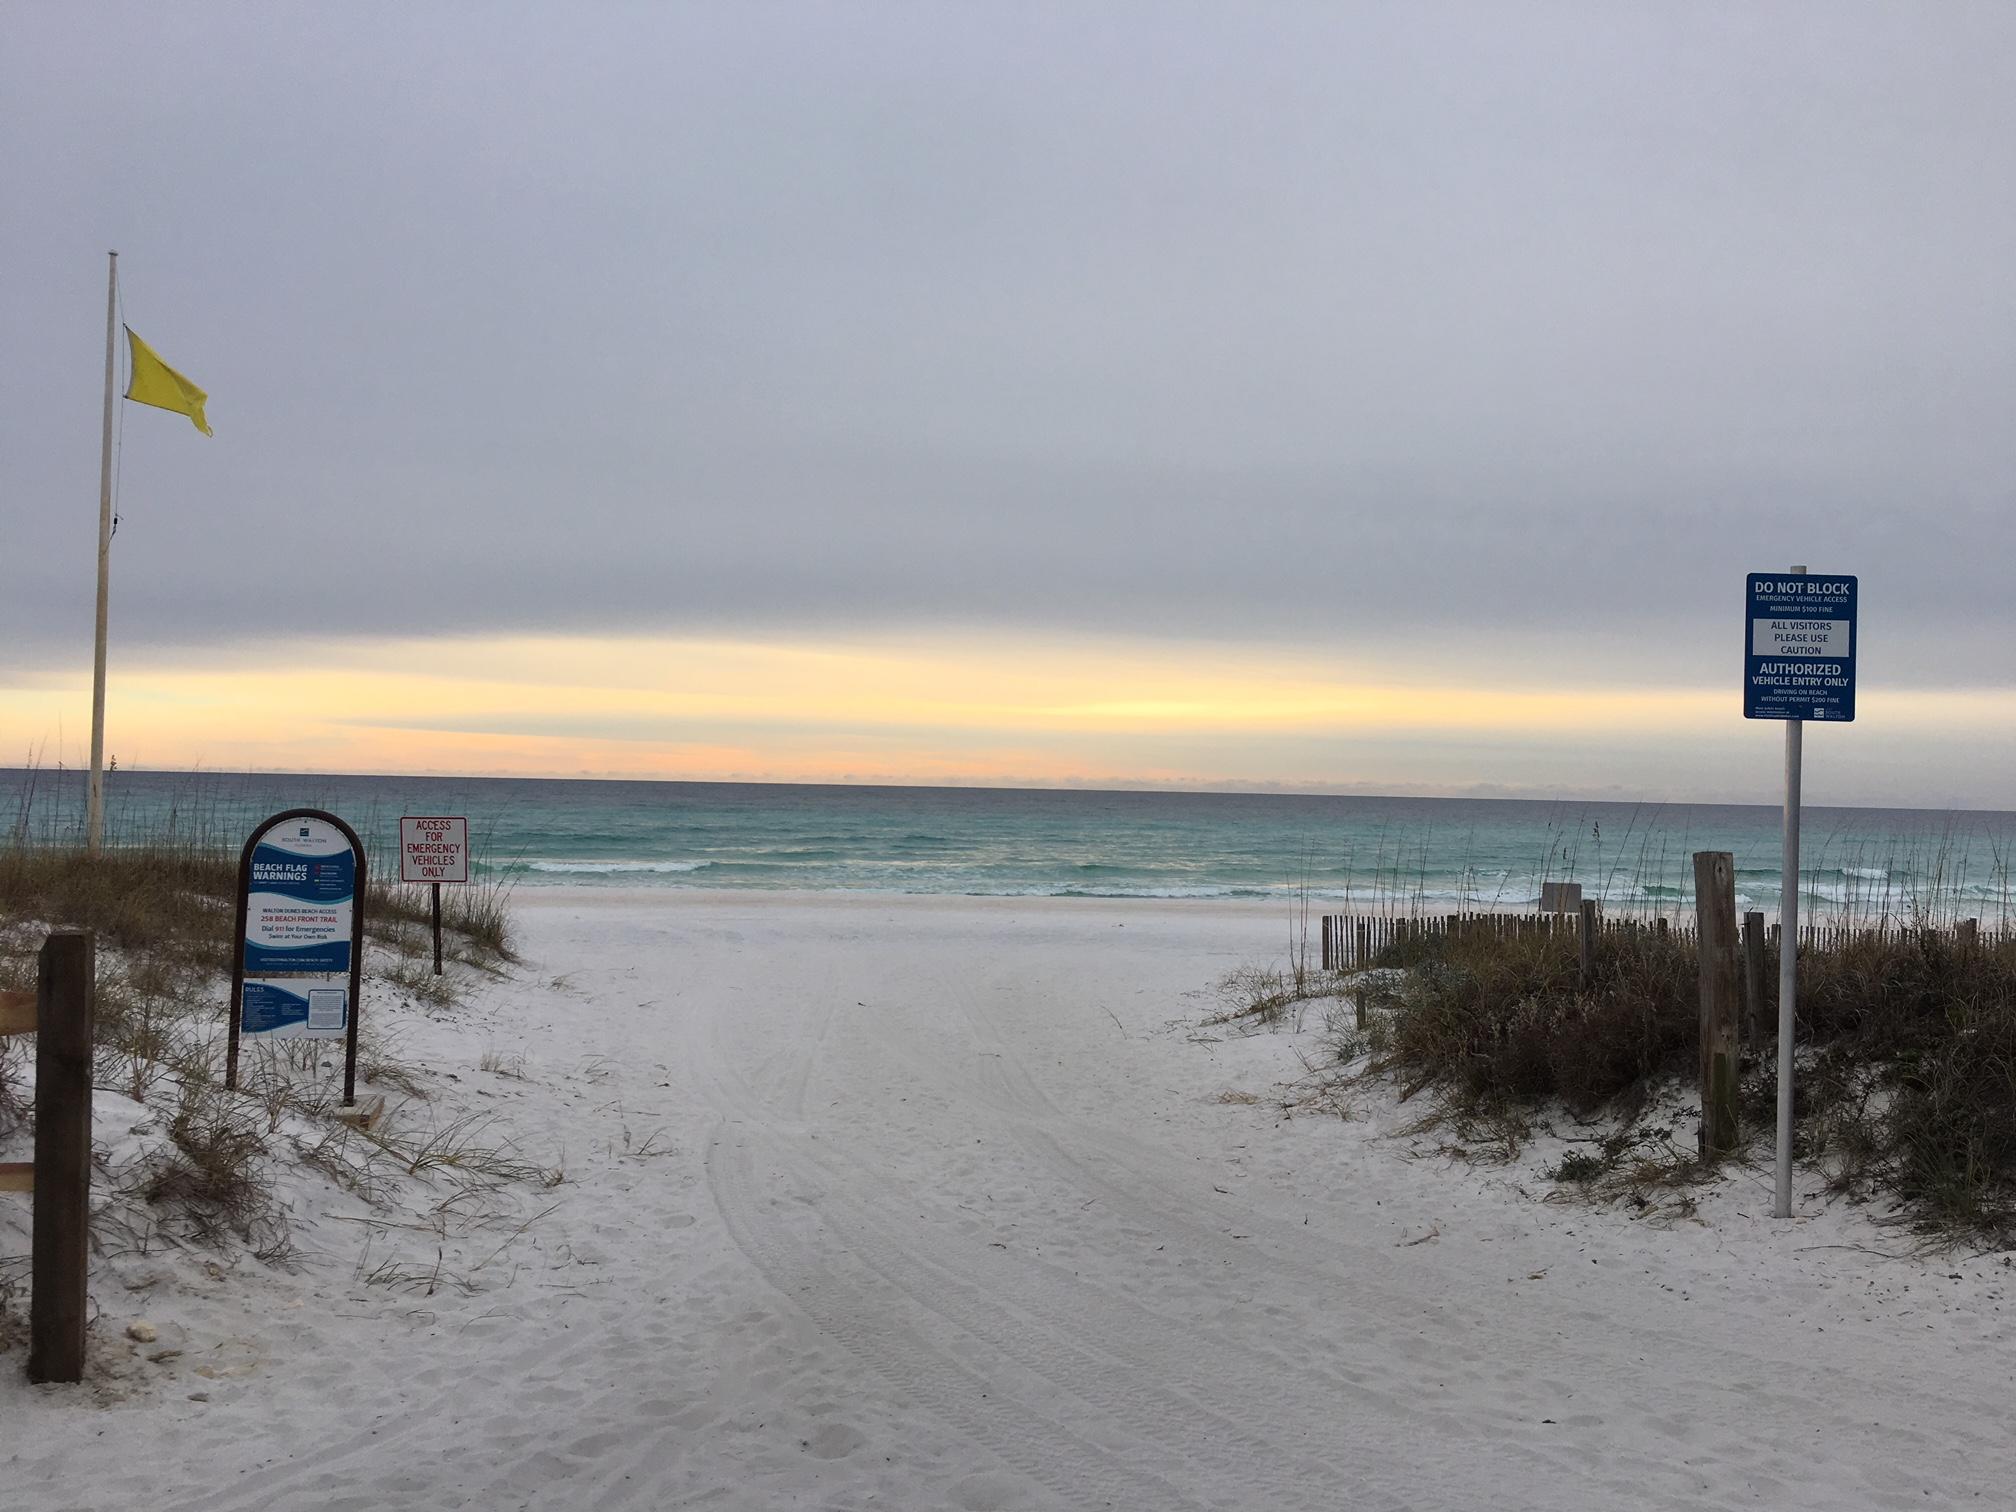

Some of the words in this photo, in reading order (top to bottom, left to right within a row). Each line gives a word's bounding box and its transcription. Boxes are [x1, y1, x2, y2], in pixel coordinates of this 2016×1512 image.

[1755, 582, 1774, 593] DO
[1778, 583, 1804, 593] NOT
[1808, 583, 1850, 595] BLOCK
[1771, 622, 1787, 630] ALL
[1790, 622, 1832, 630] VISITORS
[1774, 634, 1808, 642] PLEASE
[1810, 634, 1828, 642] USE
[1781, 646, 1822, 654] CAUTION
[1760, 663, 1841, 675] AUTHORIZED
[1753, 677, 1790, 685] VEHICLE
[1792, 677, 1822, 686] ENTRY
[1825, 678, 1848, 687] ONLY
[416, 821, 451, 830] ACCESS
[426, 832, 442, 841] FOR
[407, 844, 460, 853] EMERGENCY
[412, 856, 455, 865] VEHICLES
[253, 872, 307, 880] WARNINGS
[422, 867, 445, 876] ONLY
